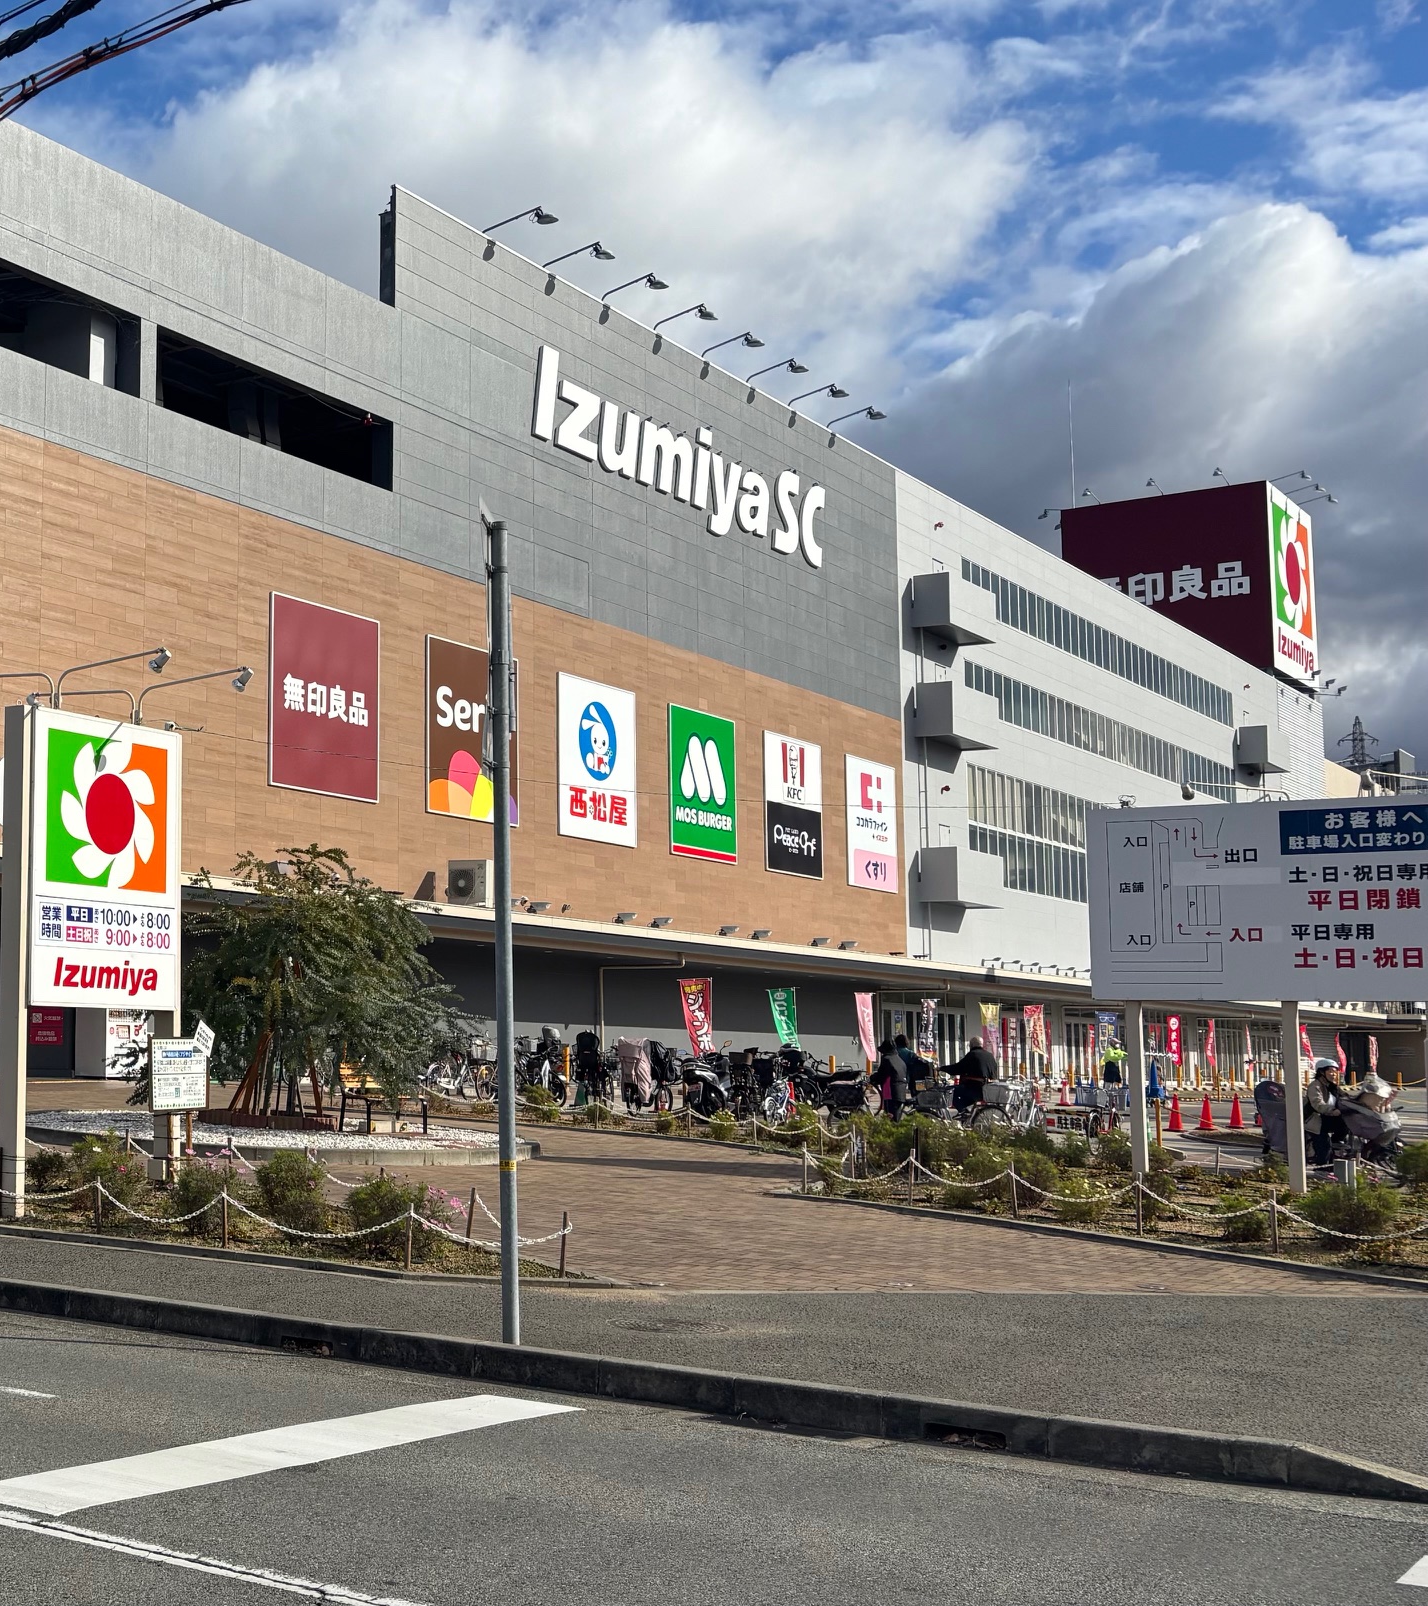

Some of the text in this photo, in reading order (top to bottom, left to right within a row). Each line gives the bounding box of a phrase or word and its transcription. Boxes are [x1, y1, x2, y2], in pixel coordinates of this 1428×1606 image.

[531, 345, 826, 569] Izumiya SC
[1098, 561, 1251, 606] 印良品
[1278, 626, 1314, 674] Izumiya
[282, 672, 369, 728] 無印良品
[436, 685, 506, 736] Ser
[786, 786, 802, 801] KFC
[569, 785, 628, 827] 西松屋
[675, 805, 733, 833] MOS BURGER
[856, 816, 888, 832] ココカラファイン
[1324, 809, 1424, 830] お客様へ
[774, 824, 800, 849] Peace
[1123, 837, 1148, 847] 入口
[1288, 831, 1426, 850] 駐車場入口変わり
[1224, 849, 1258, 863] 出口
[865, 860, 887, 882] くすり
[1119, 881, 1145, 893] 店舗
[1162, 883, 1169, 891] P
[1307, 887, 1422, 911] 平日閉鎖
[41, 905, 62, 921] 営業
[70, 907, 89, 922] 平日
[100, 908, 131, 927] 10:00
[146, 912, 171, 930] 8:00
[41, 923, 62, 939] 時間
[66, 927, 93, 943] 土日祝
[105, 928, 131, 947] 9:00
[146, 931, 171, 950] 8:00
[1126, 934, 1152, 946] 入口
[1229, 928, 1263, 942] 入口
[1291, 923, 1375, 941] 平日専用
[53, 957, 158, 996] Izumiya
